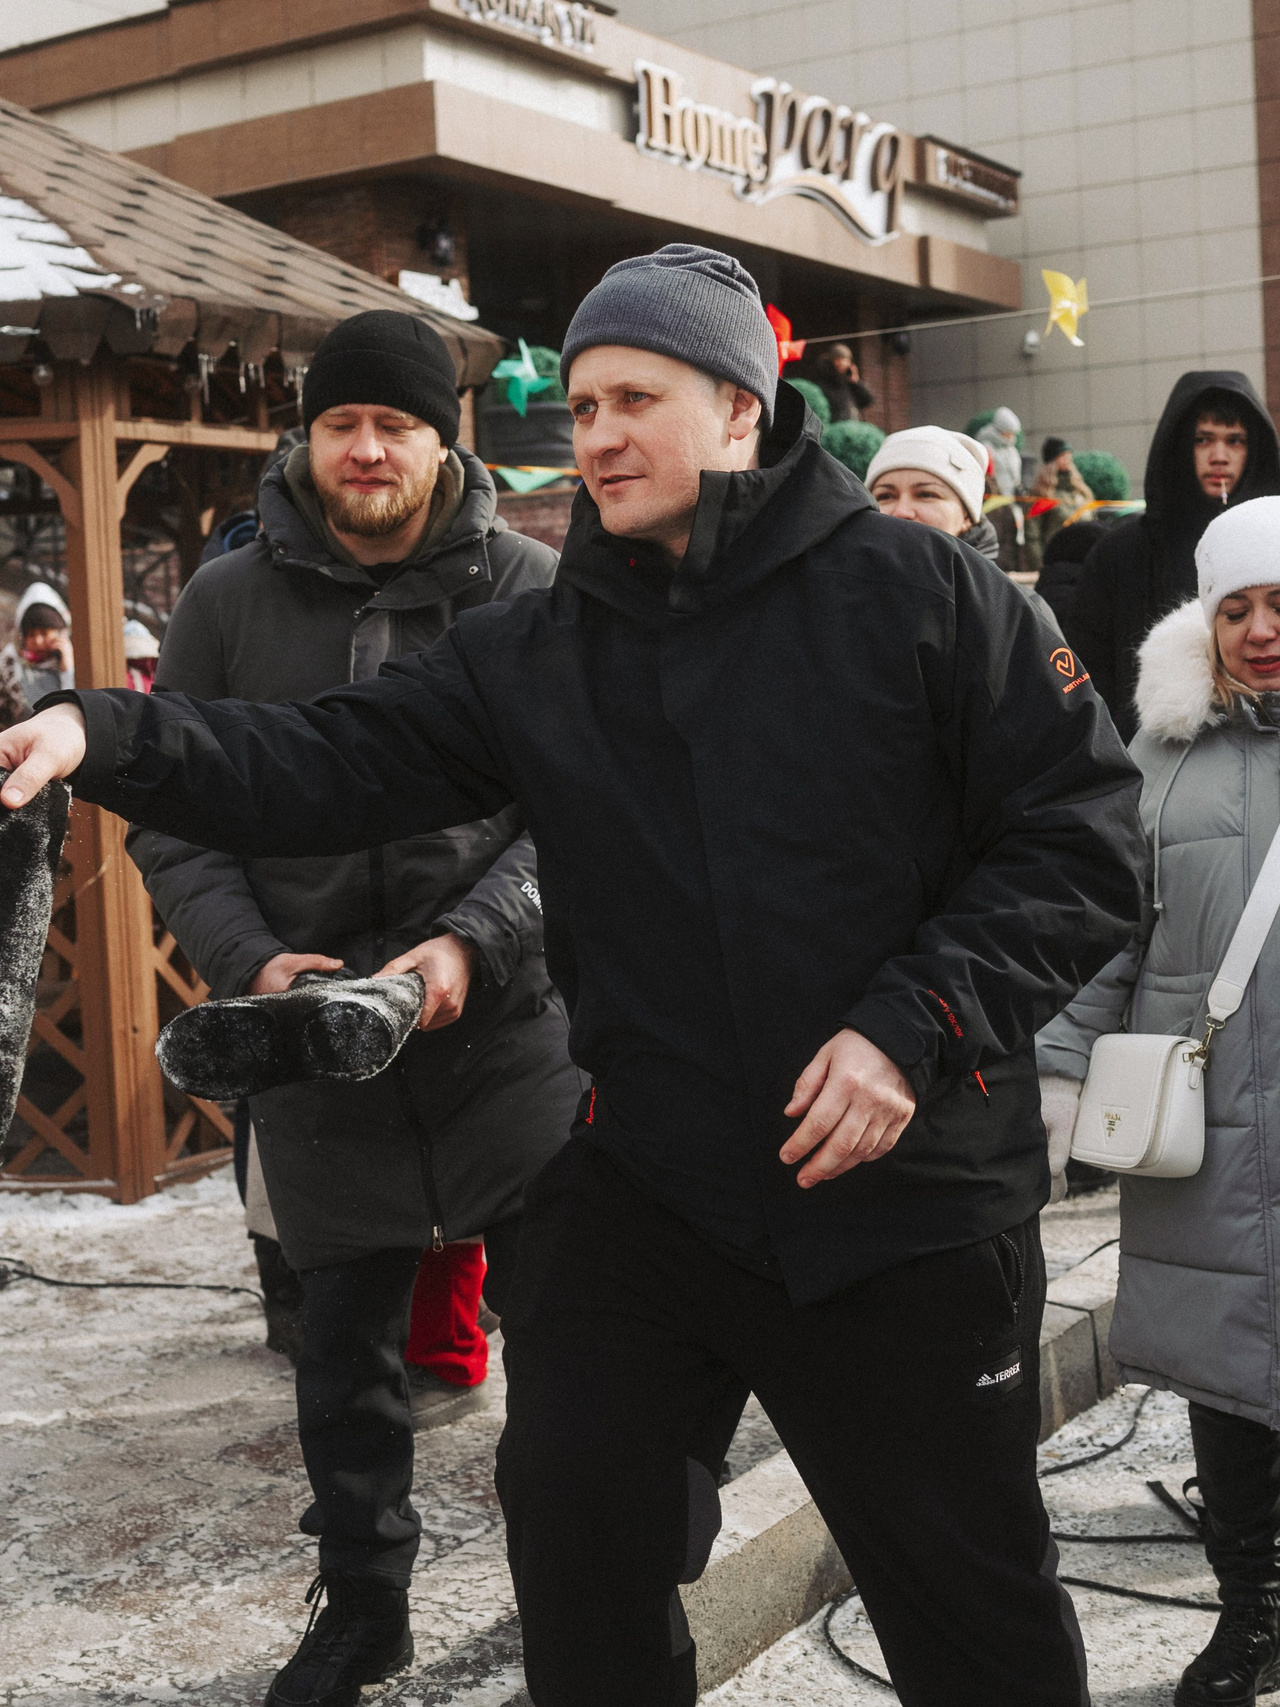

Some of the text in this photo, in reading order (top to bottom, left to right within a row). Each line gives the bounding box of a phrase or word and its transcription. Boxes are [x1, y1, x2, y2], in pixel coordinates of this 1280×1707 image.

[637, 62, 768, 183] Home
[520, 881, 543, 915] DOMI
[995, 1361, 1020, 1383] TERREX
